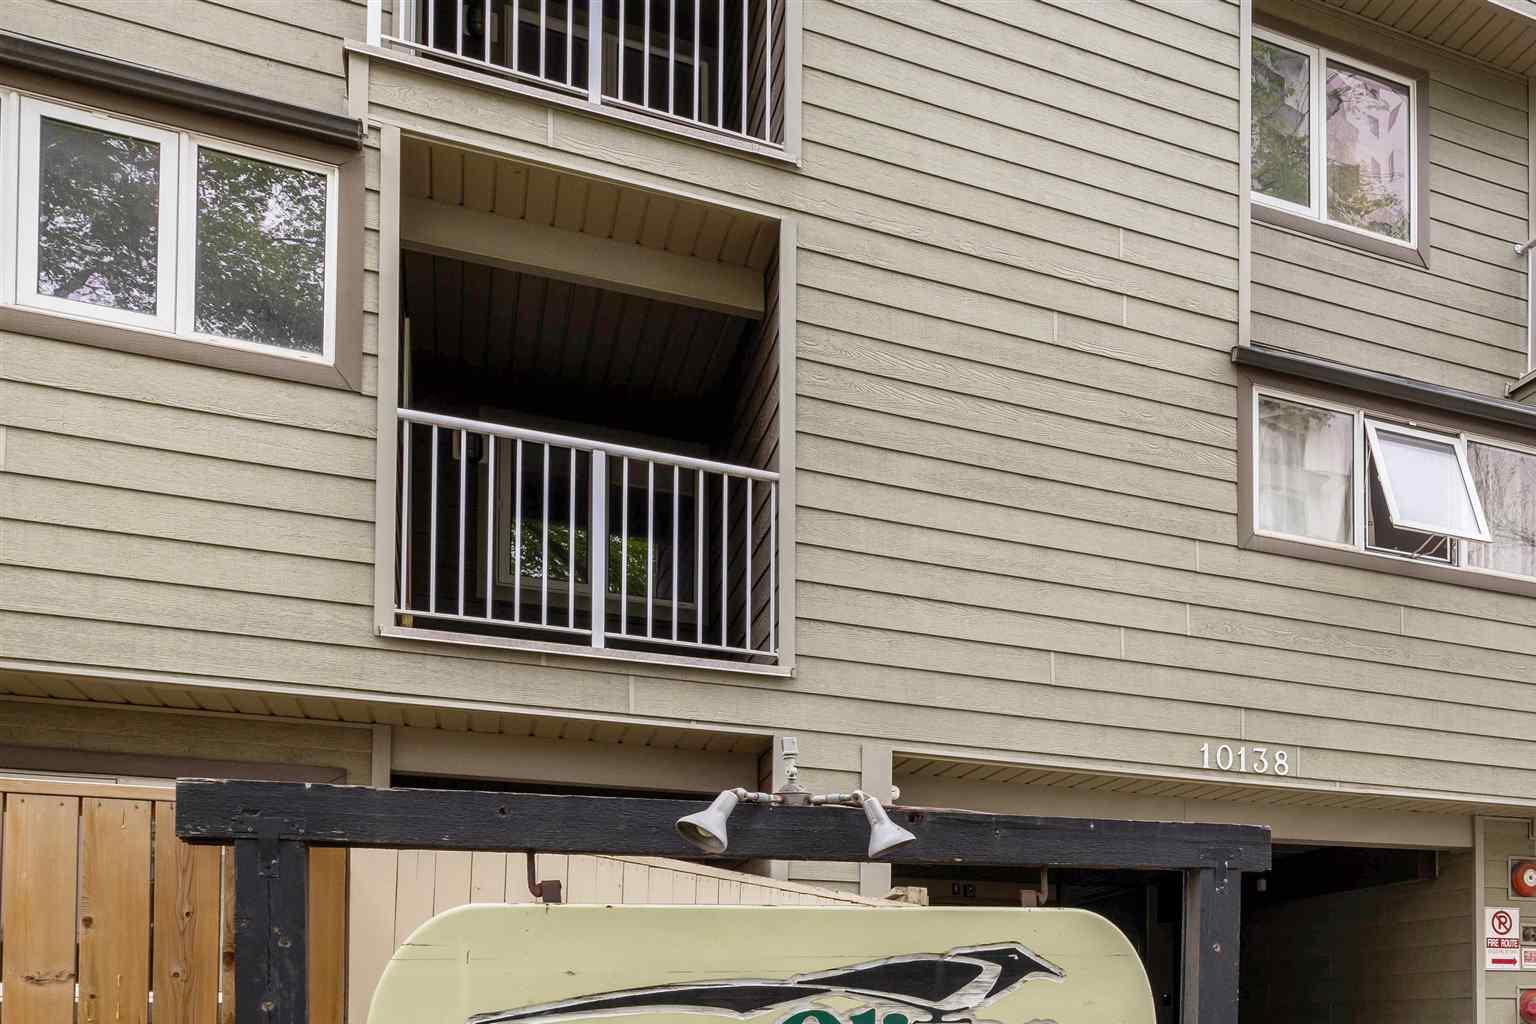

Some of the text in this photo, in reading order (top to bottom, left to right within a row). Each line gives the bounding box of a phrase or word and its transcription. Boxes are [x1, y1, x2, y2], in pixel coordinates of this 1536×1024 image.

[1200, 743, 1289, 776] 10138
[1487, 938, 1520, 949] FIRE ROUTE
